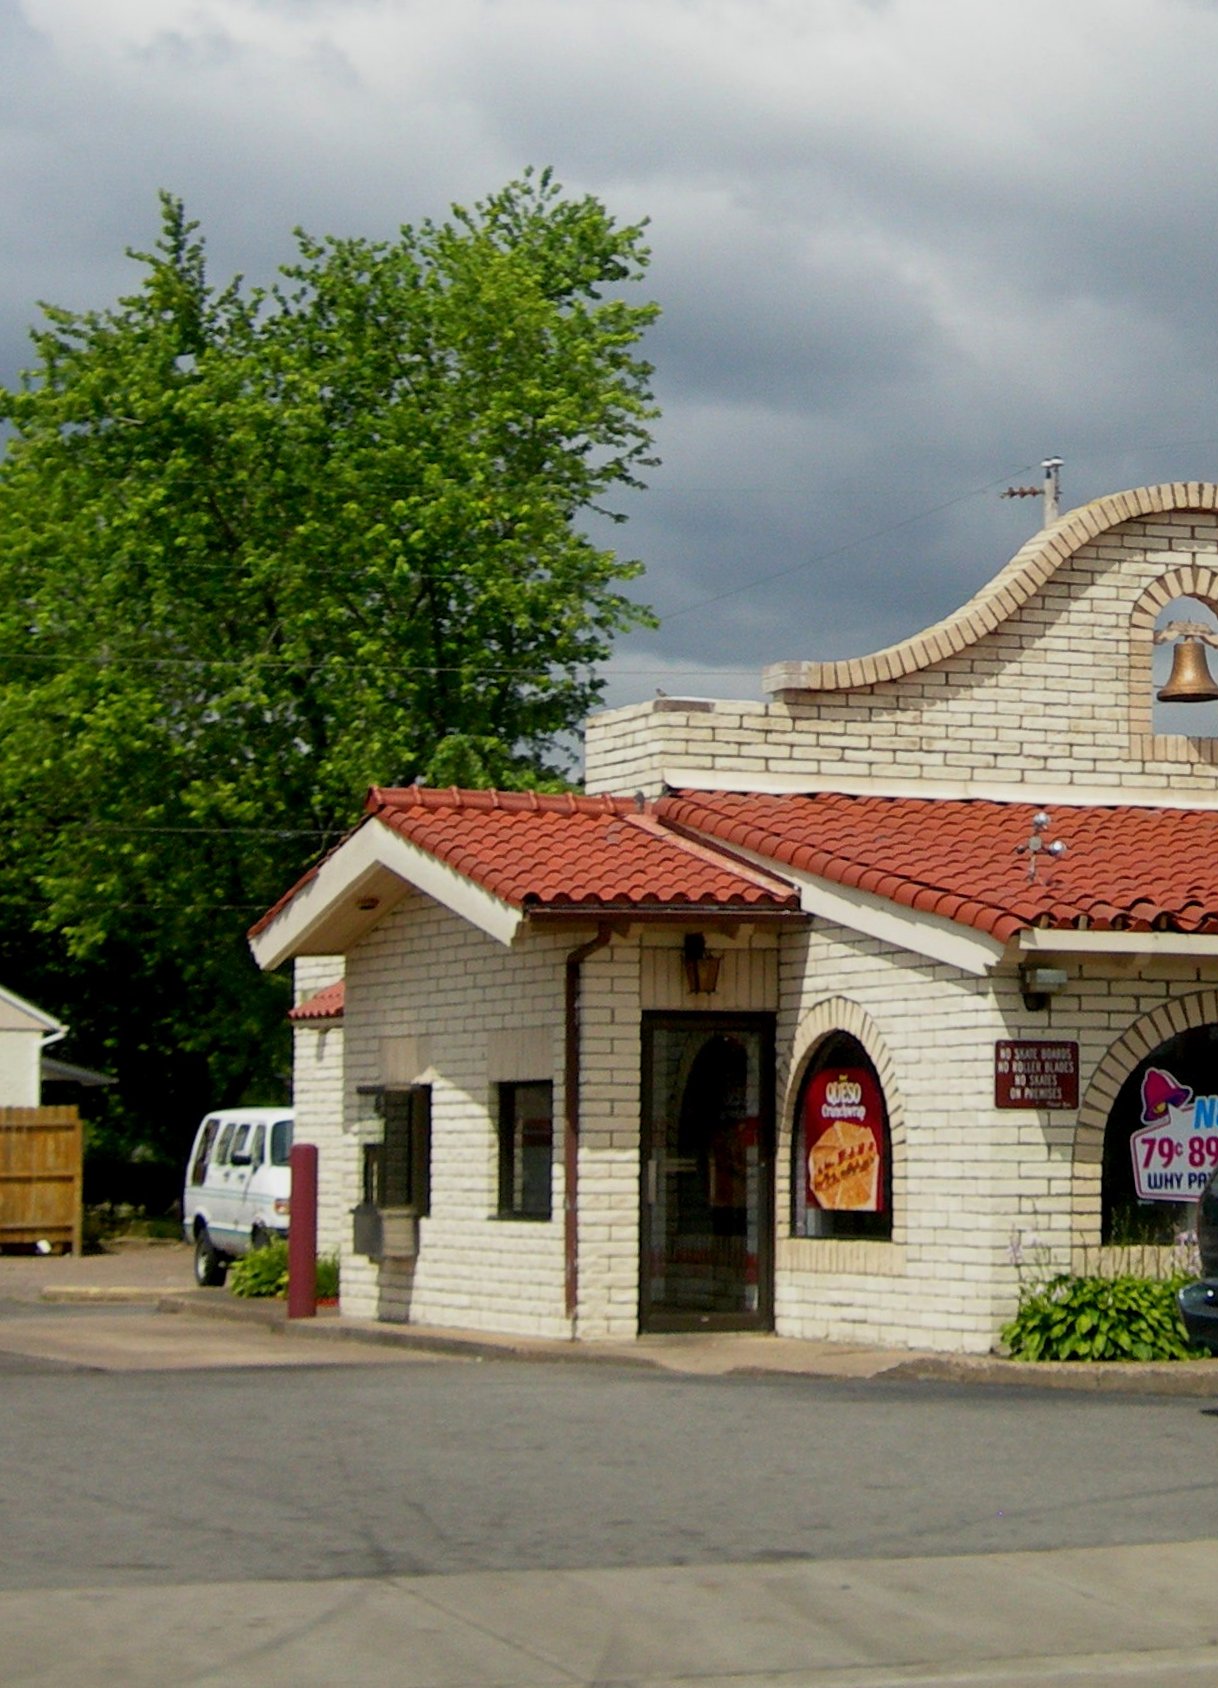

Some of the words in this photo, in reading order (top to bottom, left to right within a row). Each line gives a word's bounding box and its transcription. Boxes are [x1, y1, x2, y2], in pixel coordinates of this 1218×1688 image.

[1000, 1048, 1012, 1059] NO
[998, 1061, 1009, 1073] NO
[1014, 1074, 1026, 1086] NO
[825, 1081, 862, 1105] QUESO
[1148, 1172, 1183, 1189] WHY
[1188, 1172, 1212, 1189] PA
